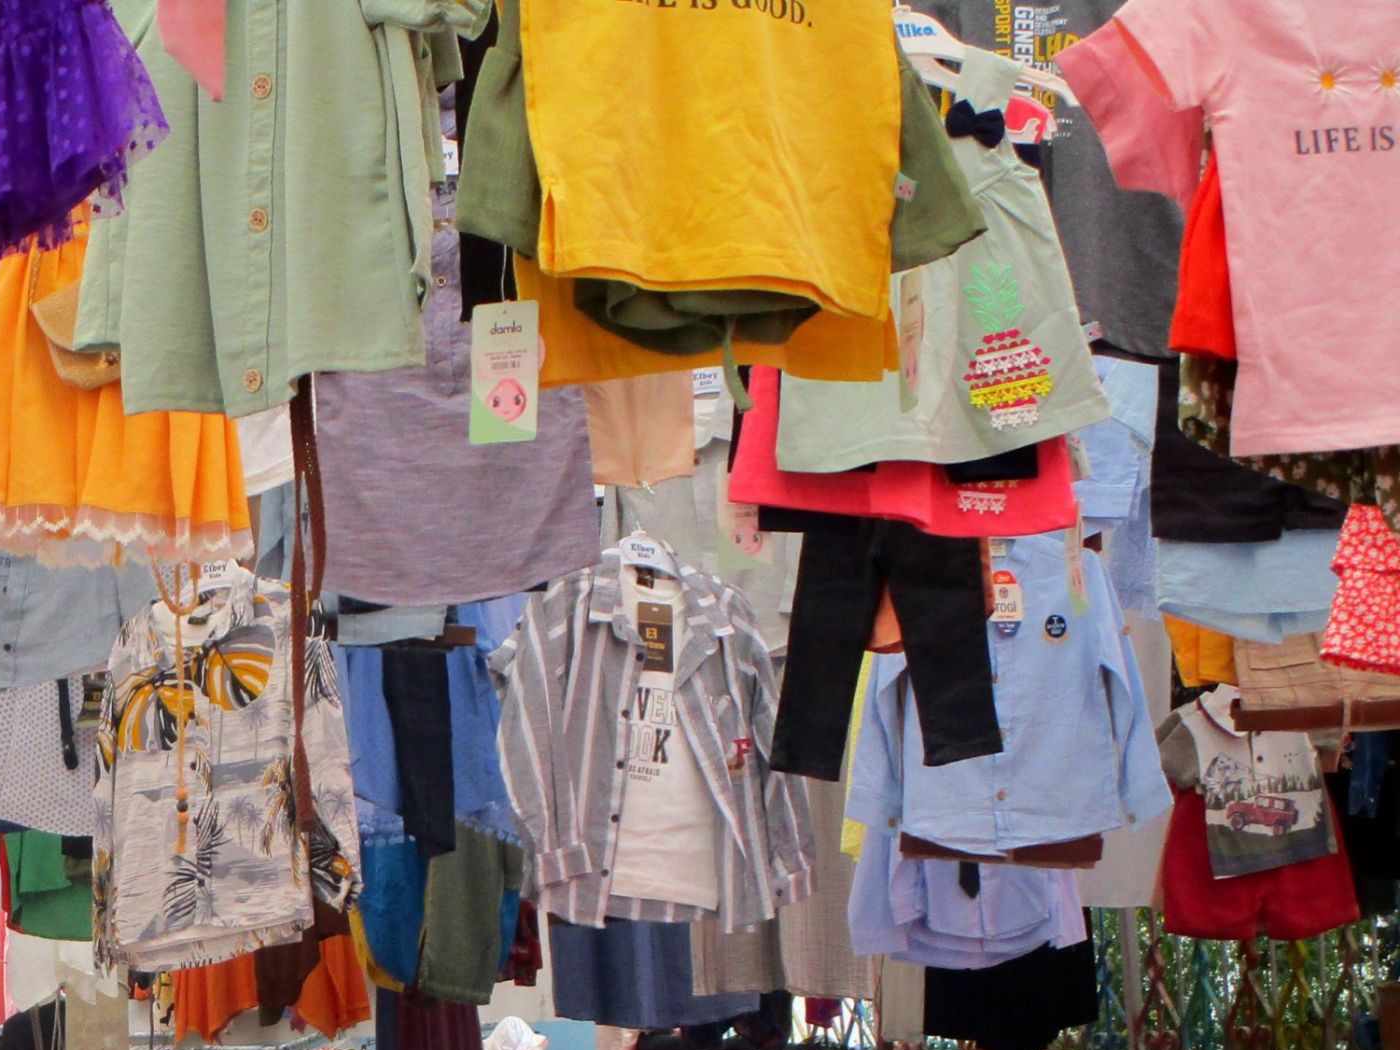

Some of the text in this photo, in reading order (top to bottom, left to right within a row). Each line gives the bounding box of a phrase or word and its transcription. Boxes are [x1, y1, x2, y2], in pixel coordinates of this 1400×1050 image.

[1014, 6, 1034, 67] GENER
[1294, 126, 1396, 155] LIFE IS
[490, 320, 522, 336] damla
